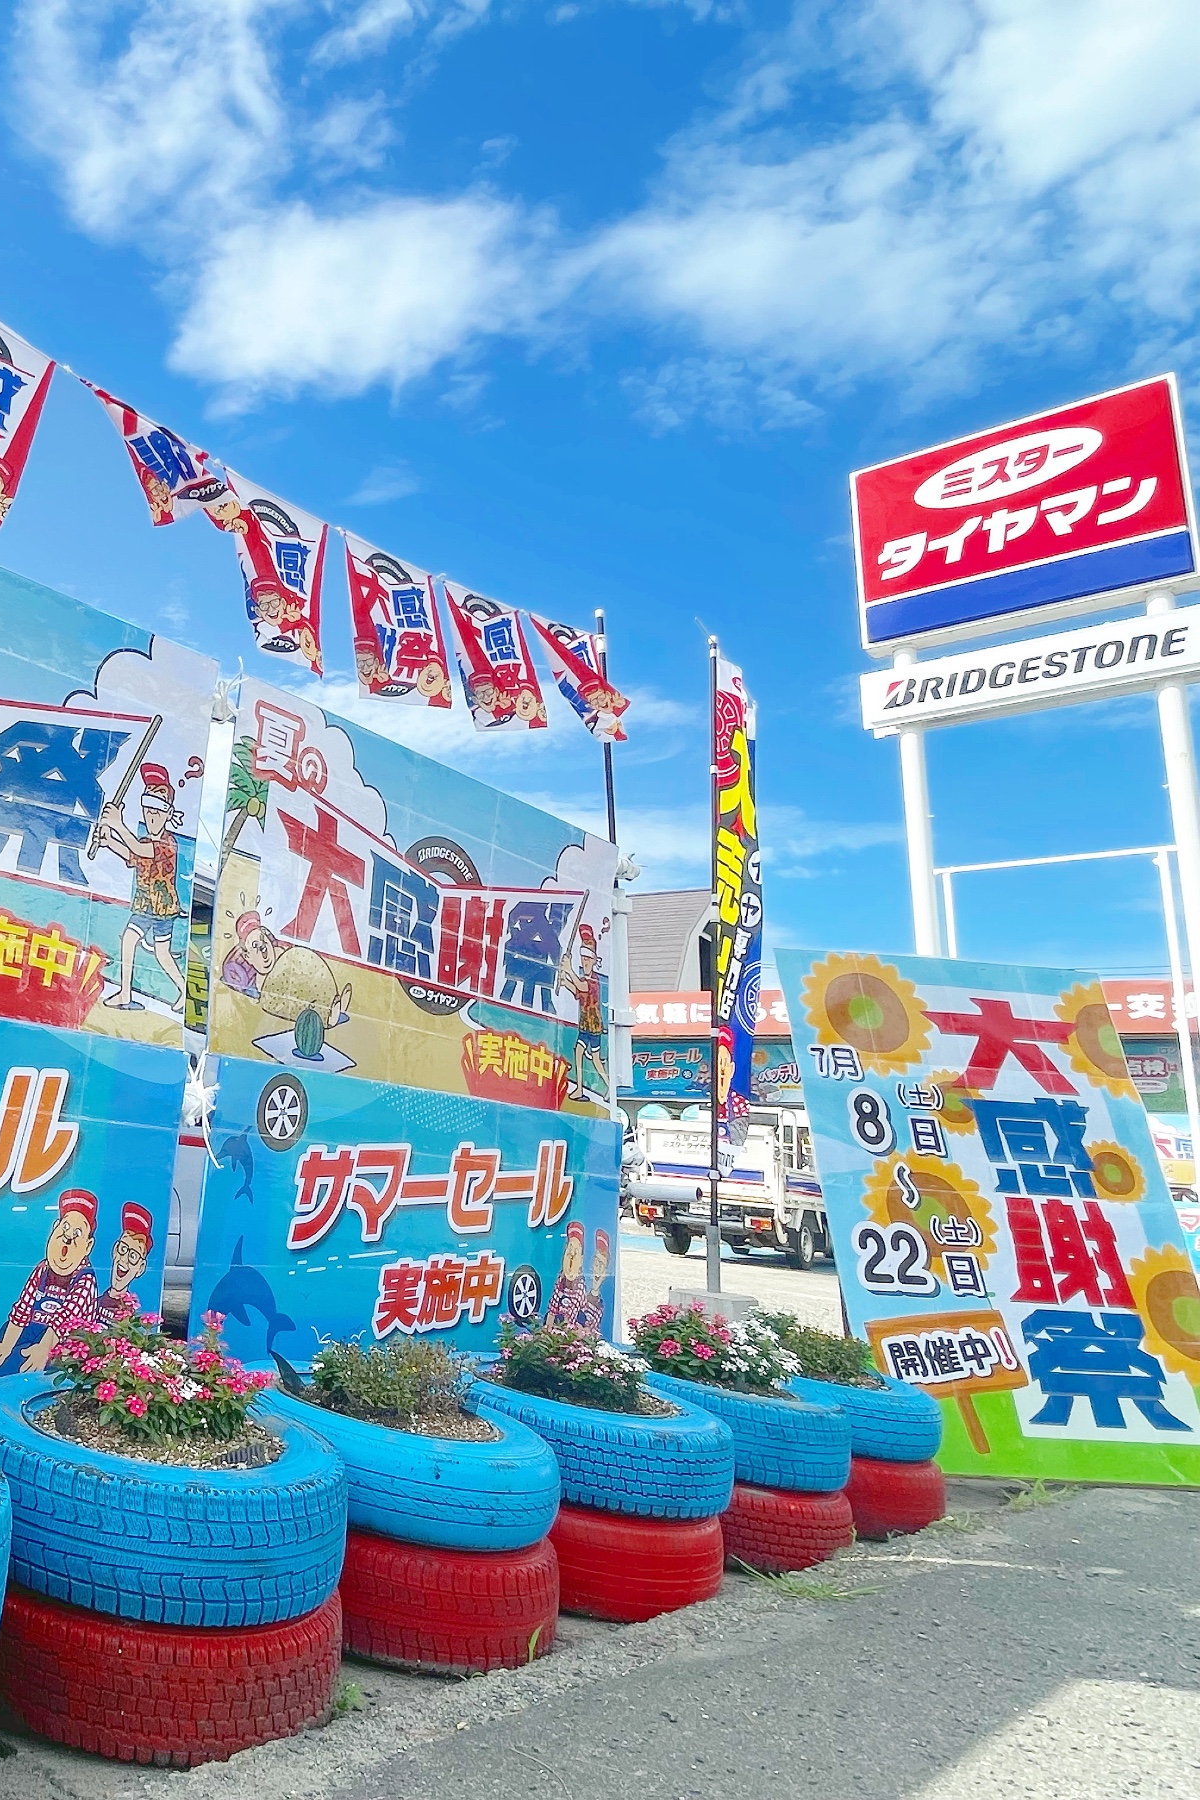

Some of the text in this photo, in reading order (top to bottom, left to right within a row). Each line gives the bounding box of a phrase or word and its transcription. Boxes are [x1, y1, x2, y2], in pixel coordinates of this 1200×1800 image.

[941, 443, 1084, 500] ミスター
[877, 476, 1158, 581] タイヤマン
[883, 627, 1189, 710] BRIDGESTONE
[251, 701, 327, 794] 夏の
[417, 846, 474, 882] BRIDGESTONE
[277, 803, 575, 1012] 大感謝祭
[478, 1033, 555, 1084] 実施中
[810, 1045, 865, 1080] 7月
[286, 1140, 574, 1250] サマーセール
[919, 997, 1195, 1432] 大感謝祭
[372, 1254, 505, 1340] 実施中
